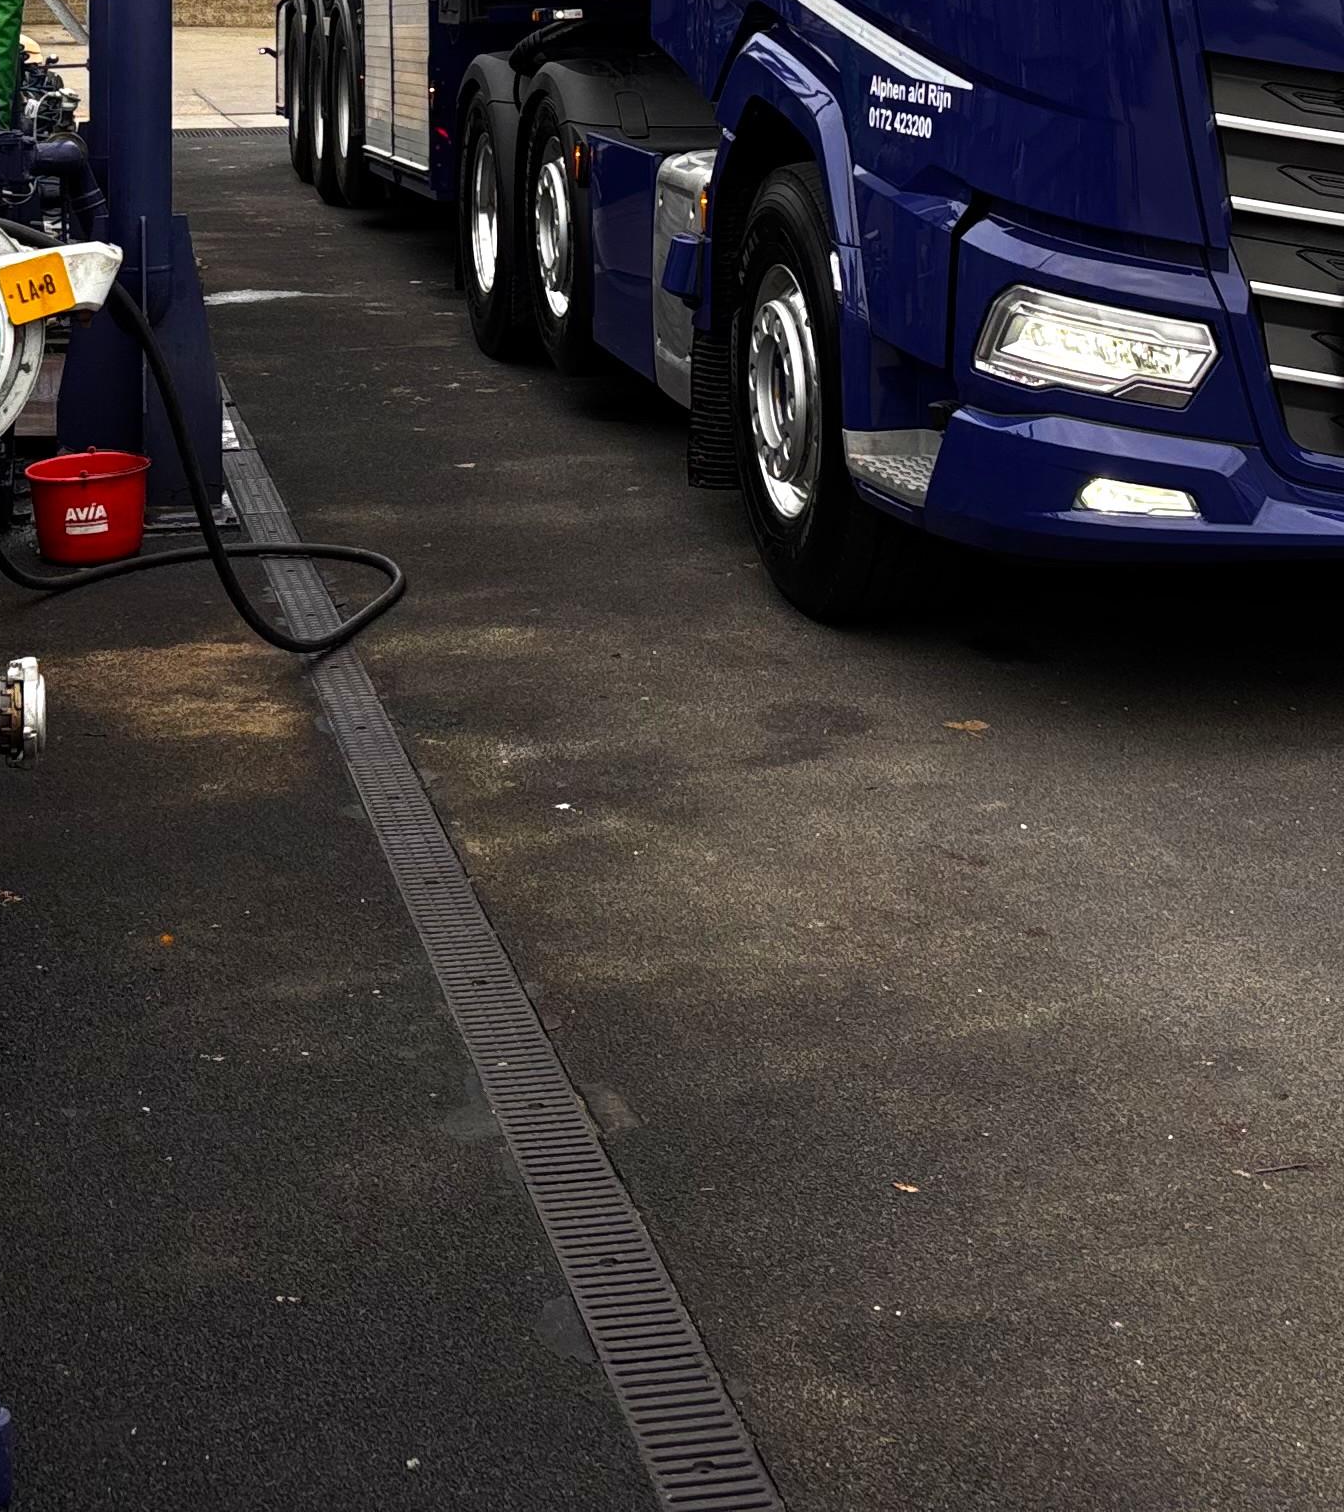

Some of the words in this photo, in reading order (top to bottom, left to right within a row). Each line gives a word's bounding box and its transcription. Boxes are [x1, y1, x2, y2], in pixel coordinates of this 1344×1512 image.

[869, 75, 906, 102] Alphen
[907, 81, 926, 105] a/d
[927, 84, 952, 113] Rijn
[869, 106, 893, 131] 0172
[893, 111, 933, 139] 423200
